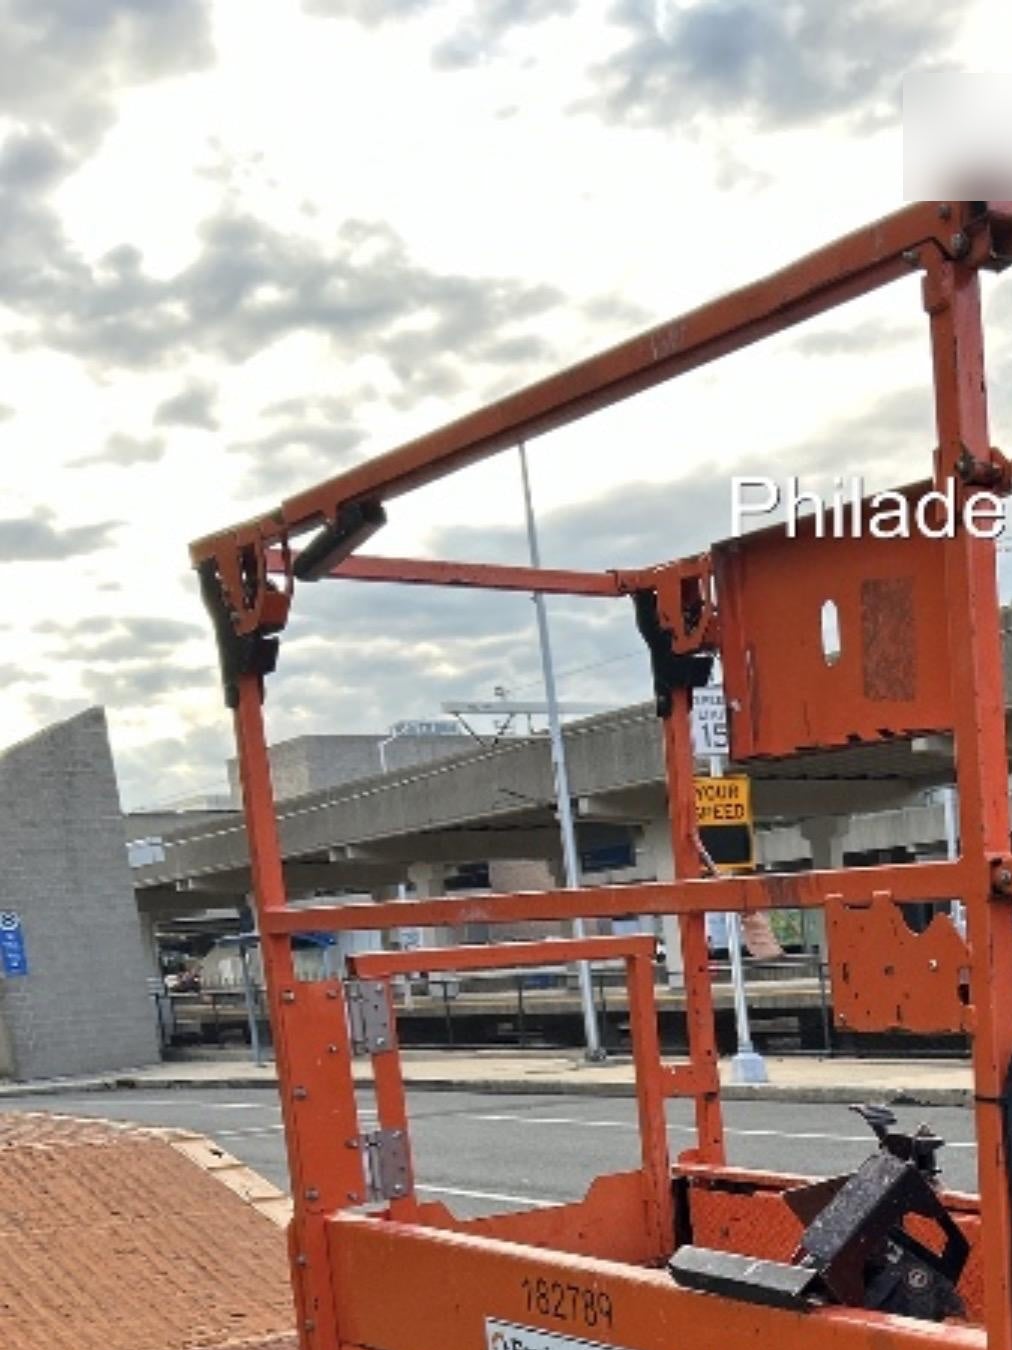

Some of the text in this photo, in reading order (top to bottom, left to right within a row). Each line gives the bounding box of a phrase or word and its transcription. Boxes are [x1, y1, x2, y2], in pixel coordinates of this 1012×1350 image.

[701, 722, 728, 748] 15
[694, 785, 740, 801] YOUR
[695, 803, 745, 820] SPEED
[521, 1276, 613, 1327] 182789
